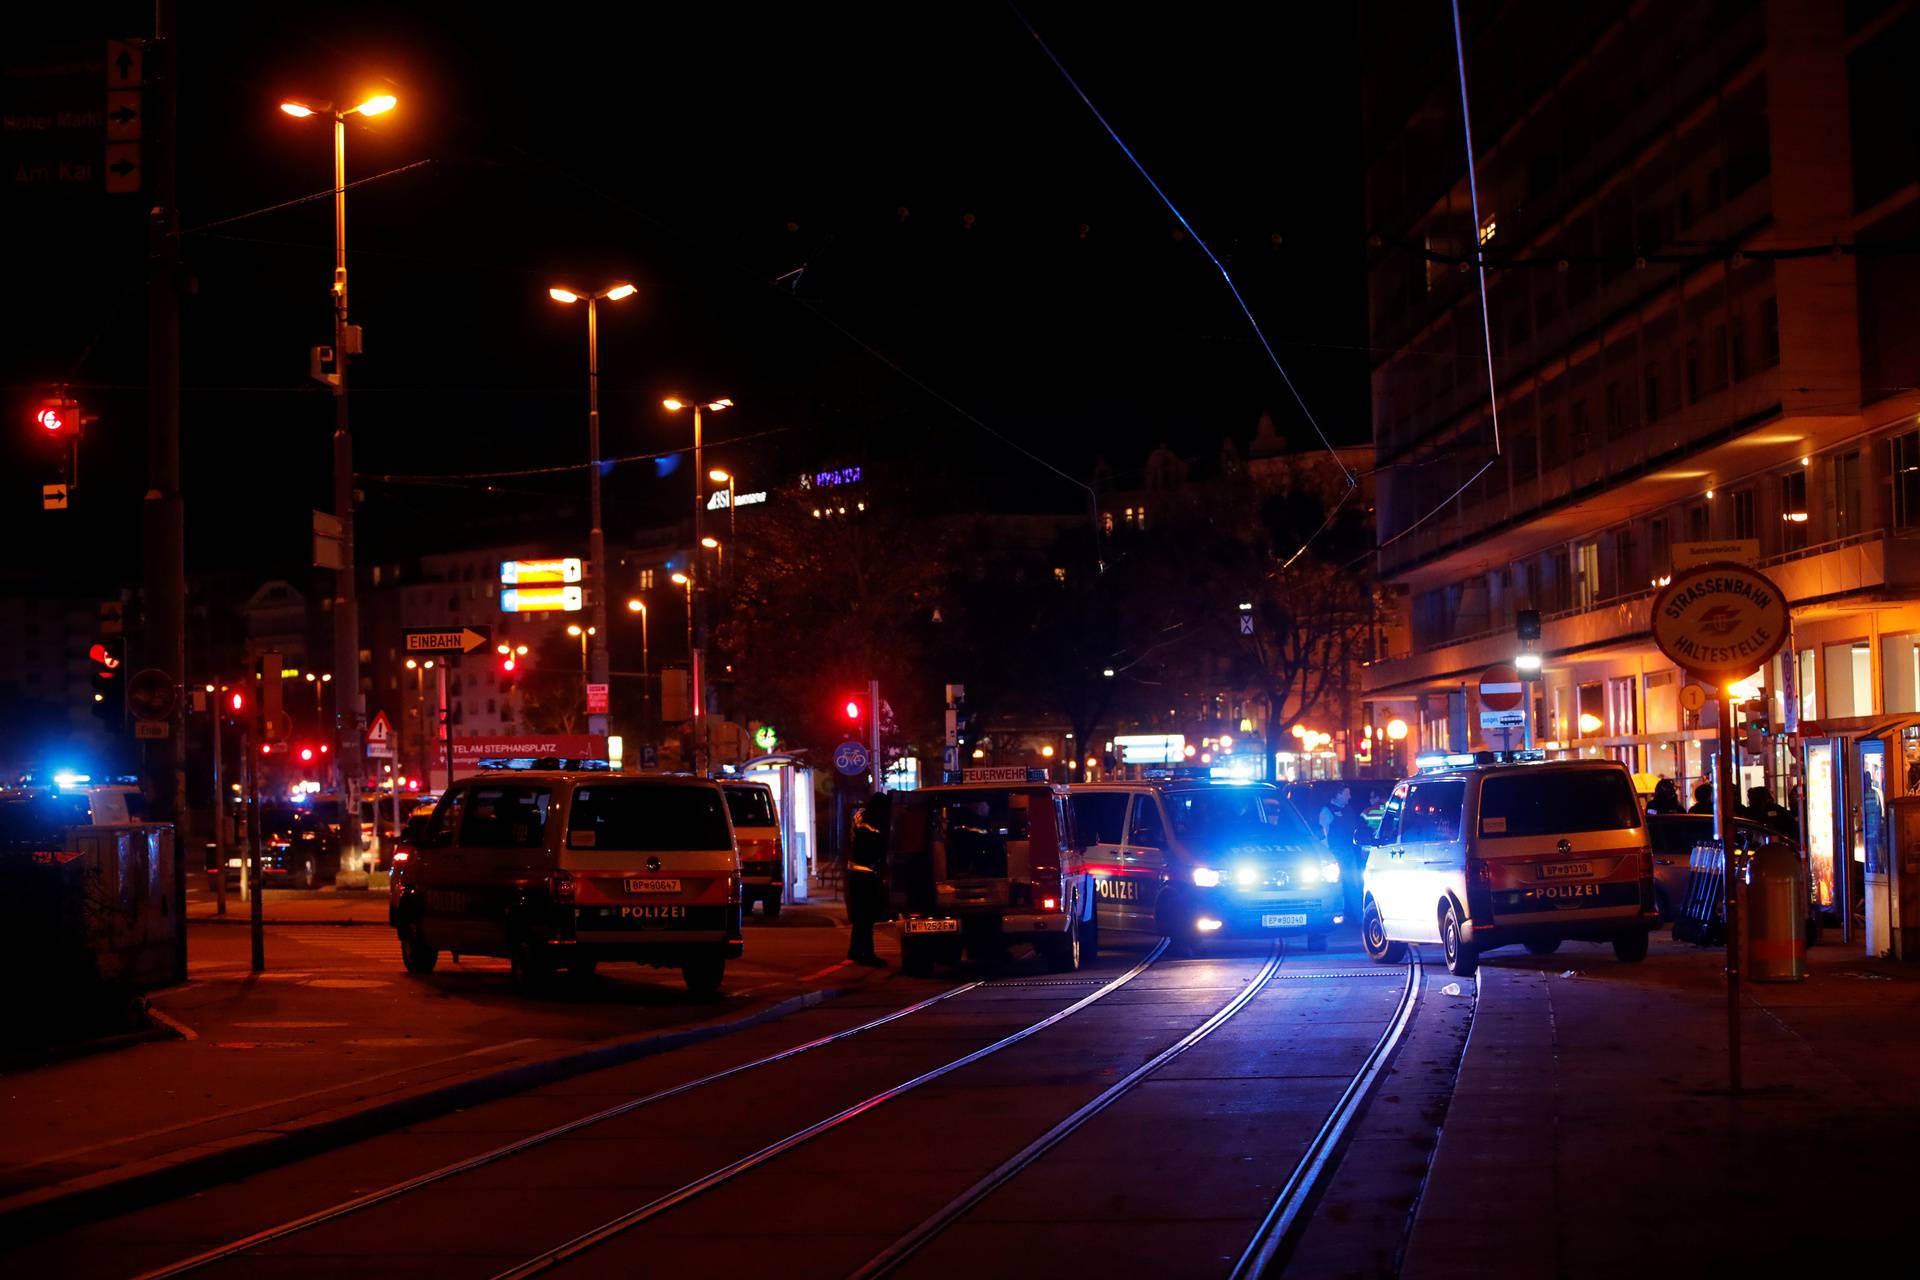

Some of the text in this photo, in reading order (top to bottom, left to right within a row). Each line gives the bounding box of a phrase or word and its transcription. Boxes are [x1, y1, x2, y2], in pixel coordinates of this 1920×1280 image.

[1665, 578, 1772, 620] STRASSENBAHN
[410, 634, 462, 648] EINBAHN
[1673, 627, 1771, 662] HALTESTELLE
[470, 744, 484, 754] AM
[484, 743, 557, 753] STEPHANSPLATZ
[964, 768, 1026, 781] FEUERWEHR
[1536, 884, 1600, 899] POLIZEI
[622, 906, 686, 918] POLIZEI
